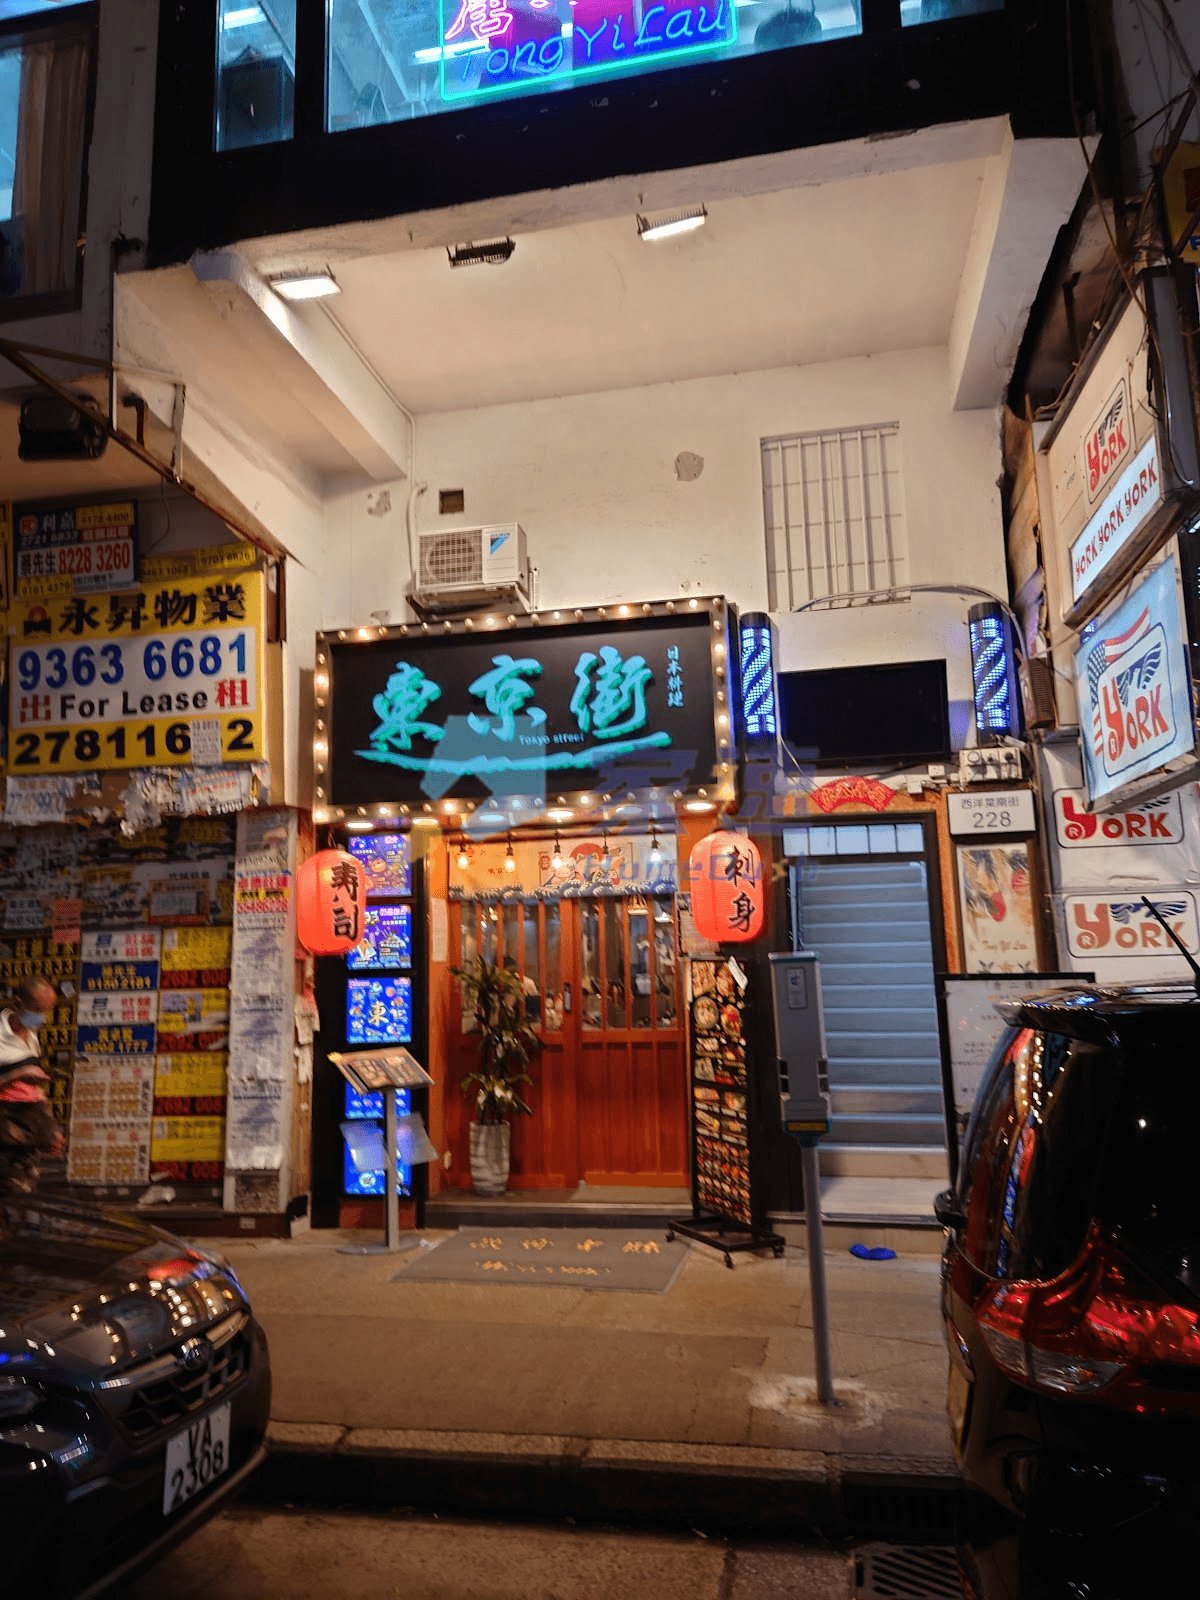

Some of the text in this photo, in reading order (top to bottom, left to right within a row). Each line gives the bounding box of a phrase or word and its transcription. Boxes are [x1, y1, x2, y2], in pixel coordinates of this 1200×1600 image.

[454, 36, 565, 82] Tong
[575, 14, 625, 58] Yi
[633, 2, 726, 46] Lau
[1098, 500, 1125, 551] YORK
[1125, 457, 1158, 517] YORK
[59, 547, 91, 574] 8228
[96, 542, 130, 571] 3260
[19, 633, 247, 691] 9363 6681
[60, 696, 110, 720] For
[122, 690, 208, 715] Lease
[370, 644, 653, 752] 東京街
[1103, 678, 1169, 762] YORK
[518, 734, 550, 746] Tokyo
[973, 811, 1012, 829] 228
[725, 845, 757, 932] 刺身
[1074, 903, 1189, 950] YORK
[367, 999, 389, 1026] 東
[171, 1441, 224, 1508] 2308
